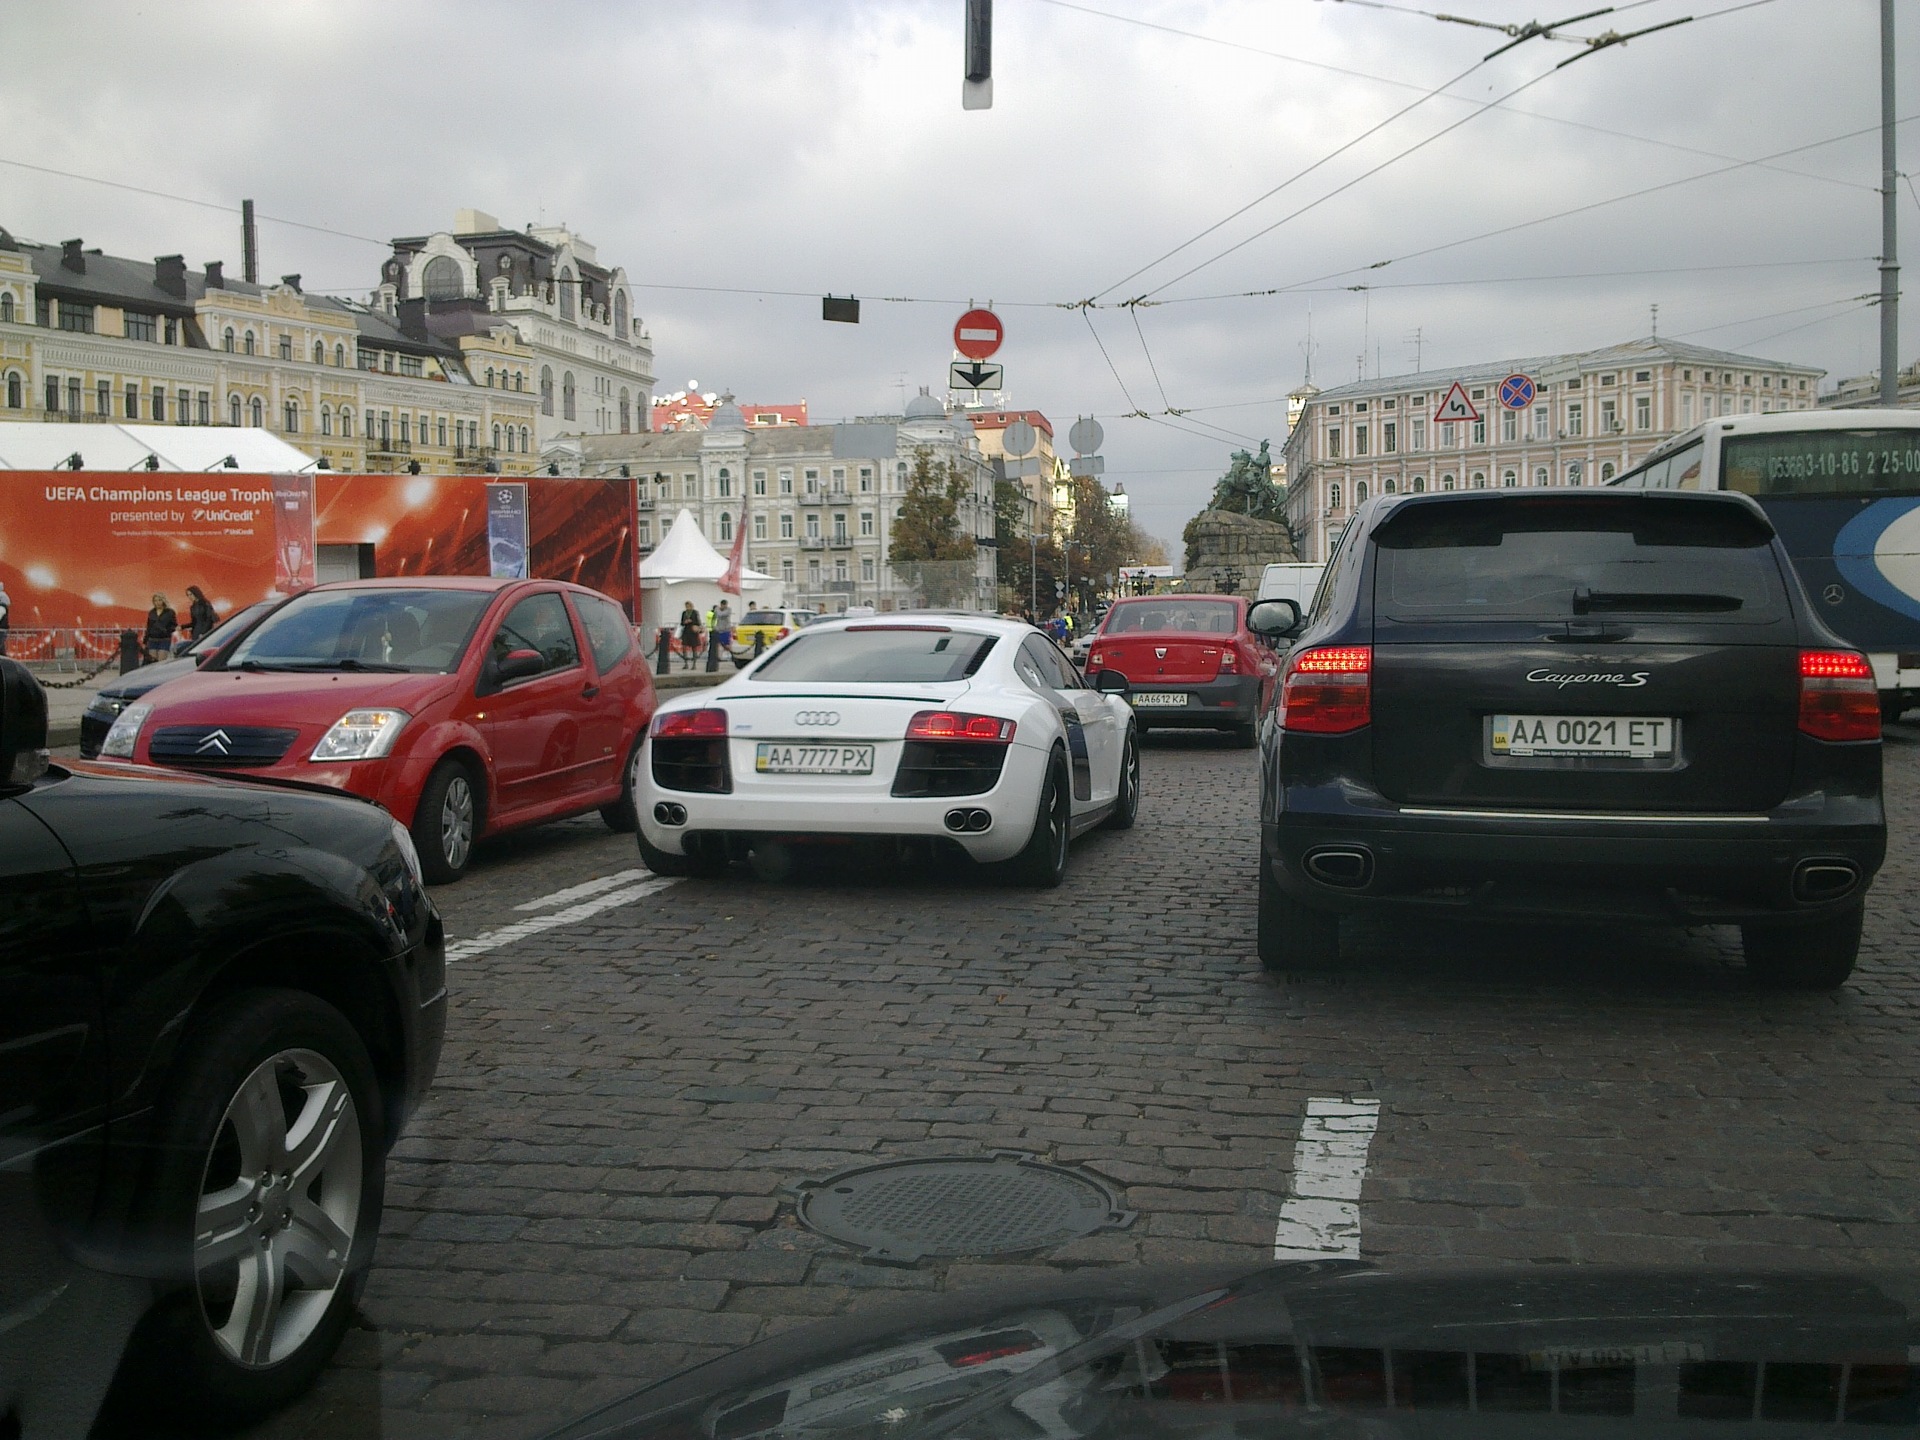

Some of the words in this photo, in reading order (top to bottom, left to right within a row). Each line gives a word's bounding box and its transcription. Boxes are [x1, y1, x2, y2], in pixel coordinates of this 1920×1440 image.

[45, 486, 86, 502] UEFA
[90, 485, 172, 504] Champions
[176, 488, 227, 504] League
[110, 510, 168, 523] presented
[171, 509, 185, 523] by
[206, 509, 254, 521] UniCredit
[1526, 668, 1626, 690] Cayenne
[1617, 671, 1650, 687] S
[1494, 736, 1507, 745] UA
[1511, 719, 1548, 745] AA
[1556, 719, 1617, 746] 0021
[1629, 720, 1665, 747] ET
[769, 748, 793, 766] AA
[798, 748, 838, 767] 7777
